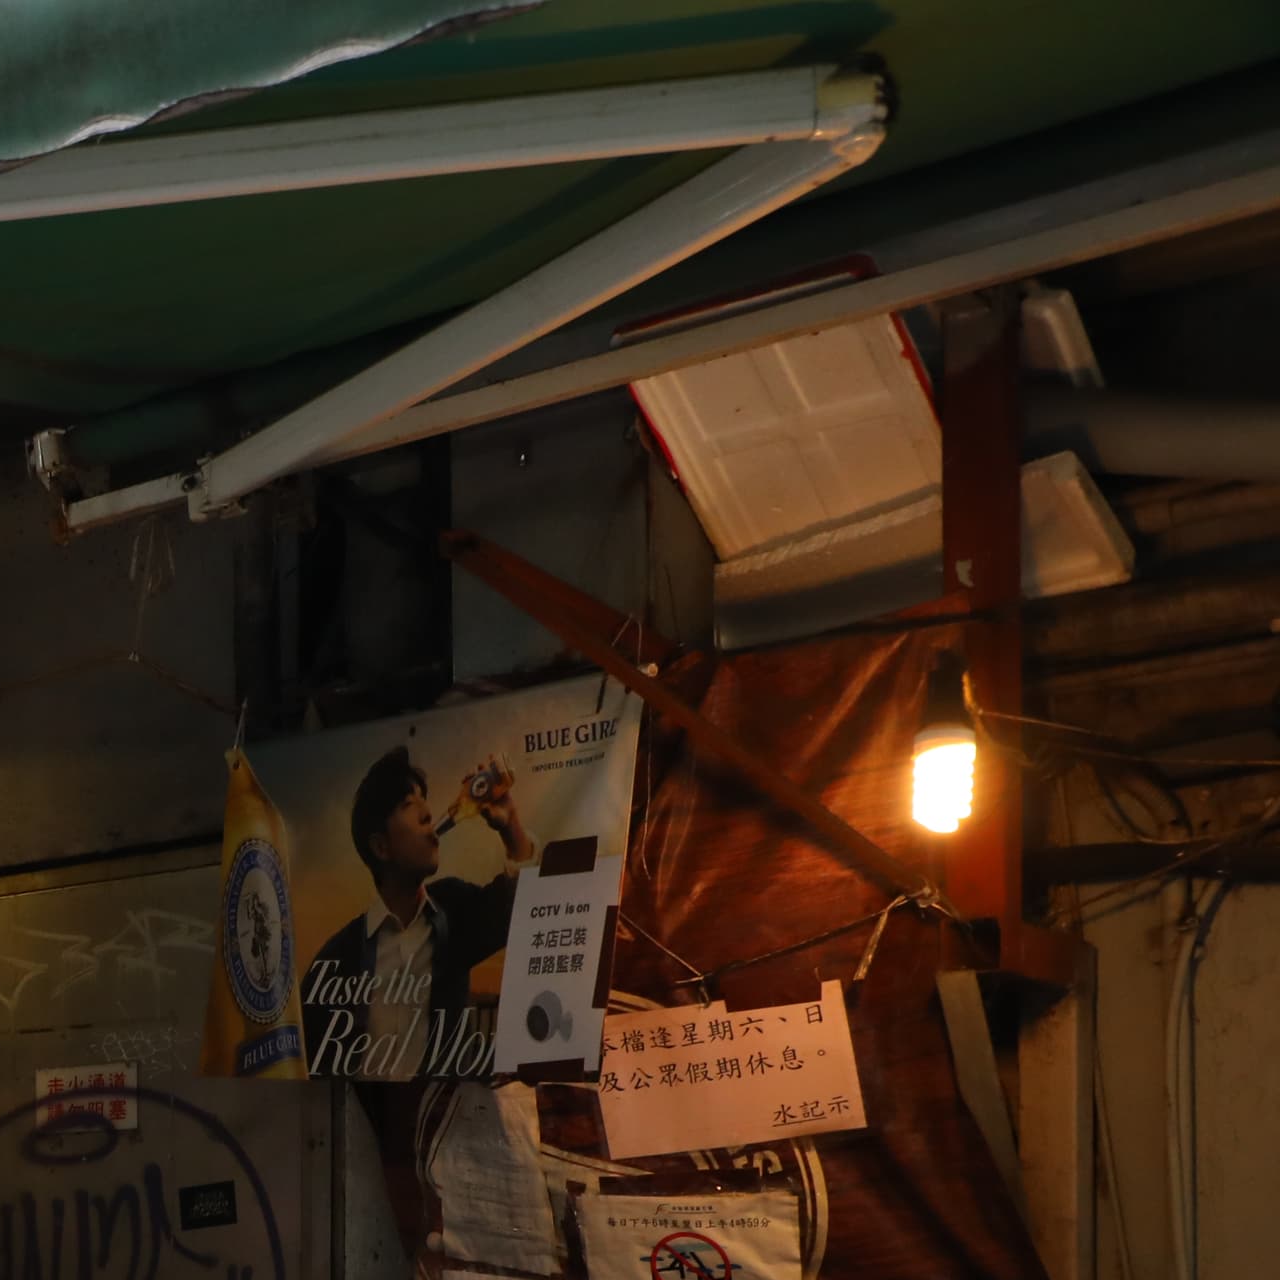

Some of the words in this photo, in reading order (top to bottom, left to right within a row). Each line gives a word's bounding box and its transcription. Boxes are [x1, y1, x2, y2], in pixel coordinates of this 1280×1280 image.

[524, 727, 571, 753] BLUE
[574, 717, 617, 744] GIRL
[530, 904, 561, 918] CCTV
[565, 902, 575, 915] is
[576, 903, 590, 913] on
[531, 926, 587, 949] 本店已裝
[528, 954, 585, 976] 閉路監察
[304, 959, 382, 1006] Taste
[383, 953, 433, 1005] the
[243, 1042, 274, 1069] BLUE
[308, 1008, 423, 1077] Real
[772, 1095, 850, 1125] 水記示
